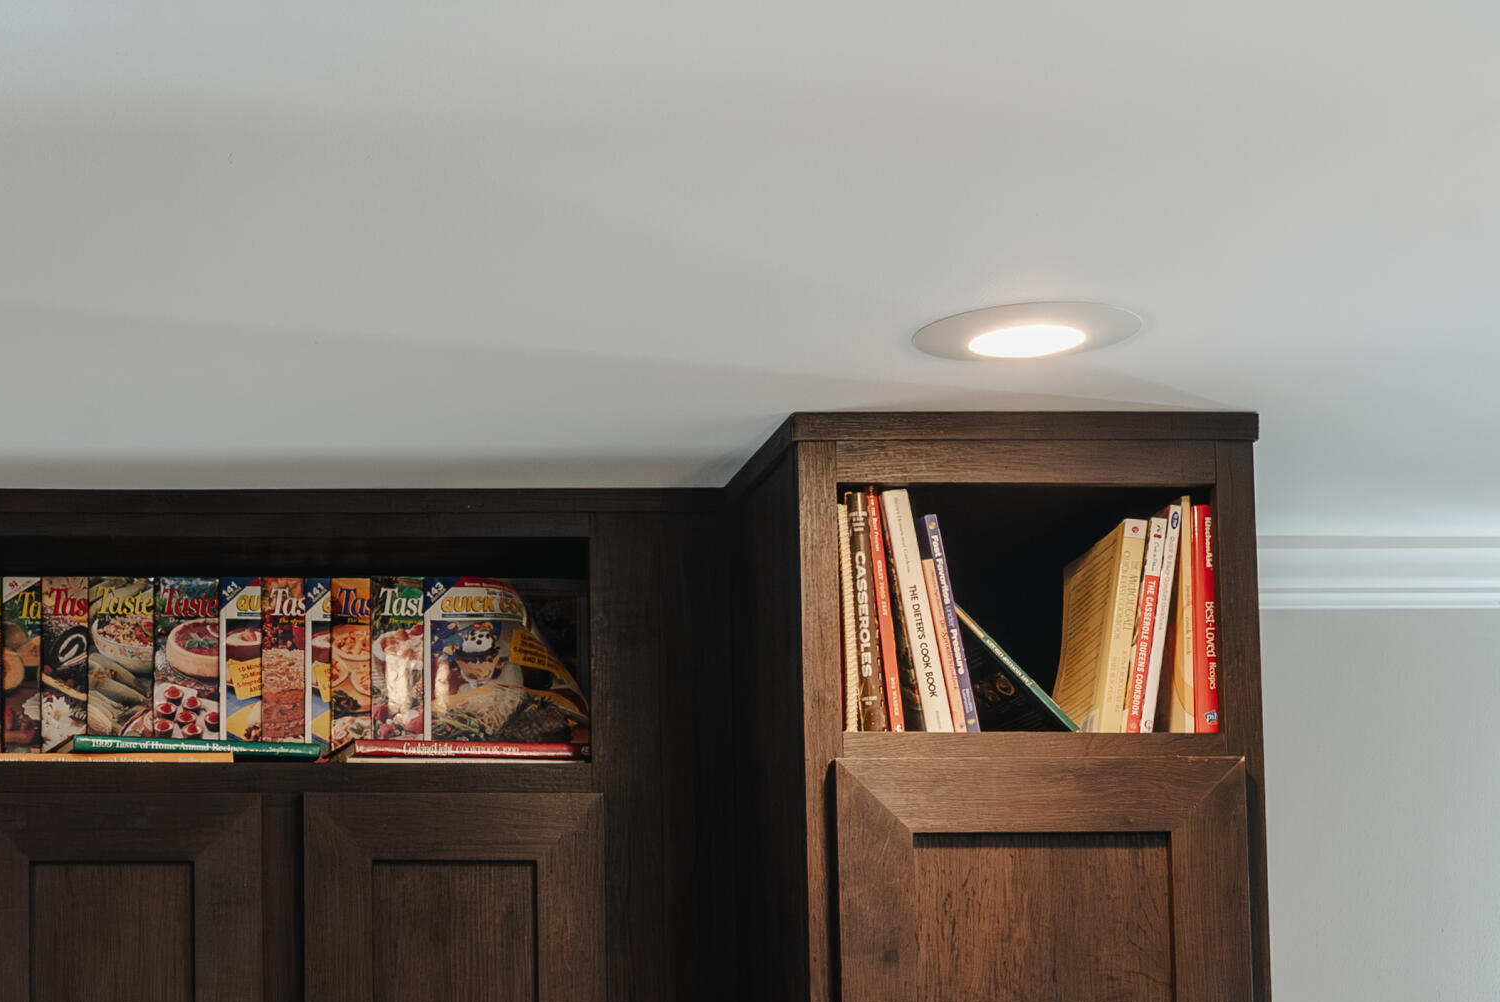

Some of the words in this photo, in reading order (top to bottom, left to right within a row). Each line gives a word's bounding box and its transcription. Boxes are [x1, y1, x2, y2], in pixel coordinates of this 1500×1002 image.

[932, 535, 941, 557] Fast
[1204, 517, 1212, 568] KitchenAid
[222, 580, 238, 597] 141
[307, 582, 325, 600] 141
[426, 581, 444, 599] 143
[908, 584, 918, 601] THE
[934, 558, 950, 604] Favorites
[1148, 580, 1156, 596] THE
[18, 591, 42, 620] Ta
[49, 588, 88, 616] Tas
[96, 586, 154, 616] Taste
[162, 587, 219, 617] Taste
[236, 594, 261, 612] QU
[270, 588, 306, 616] Tas
[442, 596, 496, 613] QUICK
[855, 551, 872, 678] CASSEROLES
[912, 604, 926, 640] DIETER'S
[944, 605, 955, 628] under
[1141, 596, 1154, 640] CASSEROLE
[1205, 601, 1216, 658] Best-Loved
[920, 642, 932, 669] COOK
[950, 628, 964, 675] Pressure
[1137, 642, 1148, 672] QUEENS
[926, 672, 938, 698] BOOK
[1208, 662, 1216, 690] Recipes
[1132, 674, 1144, 716] COOKBOOK
[116, 740, 138, 749] Taste
[140, 740, 150, 749] of
[150, 741, 178, 750] Home
[179, 742, 209, 752] Annual
